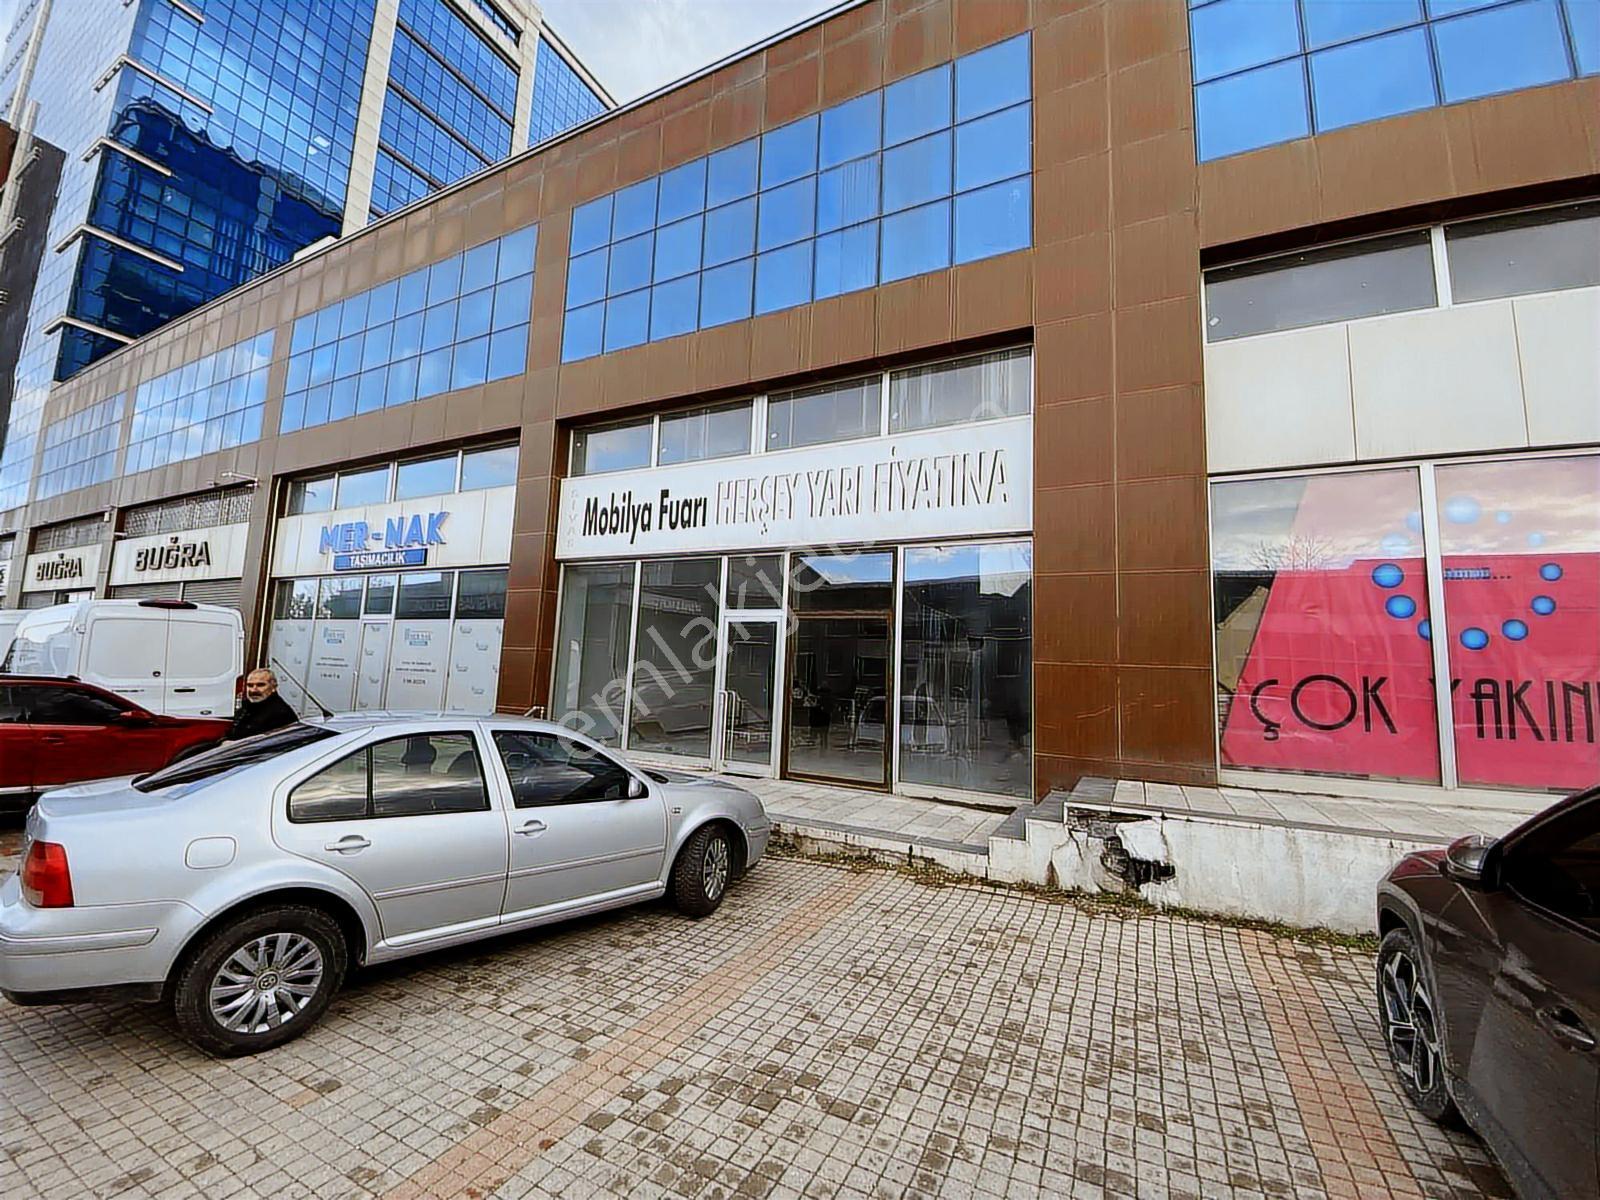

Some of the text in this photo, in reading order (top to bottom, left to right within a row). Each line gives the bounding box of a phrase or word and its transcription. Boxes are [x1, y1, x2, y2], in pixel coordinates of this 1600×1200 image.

[582, 446, 1008, 545] Mobilya Fuarı HERŞEY YARI FİYATINA
[36, 553, 82, 581] BUĞRA
[135, 536, 212, 572] BUĞRA
[349, 551, 406, 568] TAŞIMACILIK
[1250, 674, 1398, 741] ÇOK
